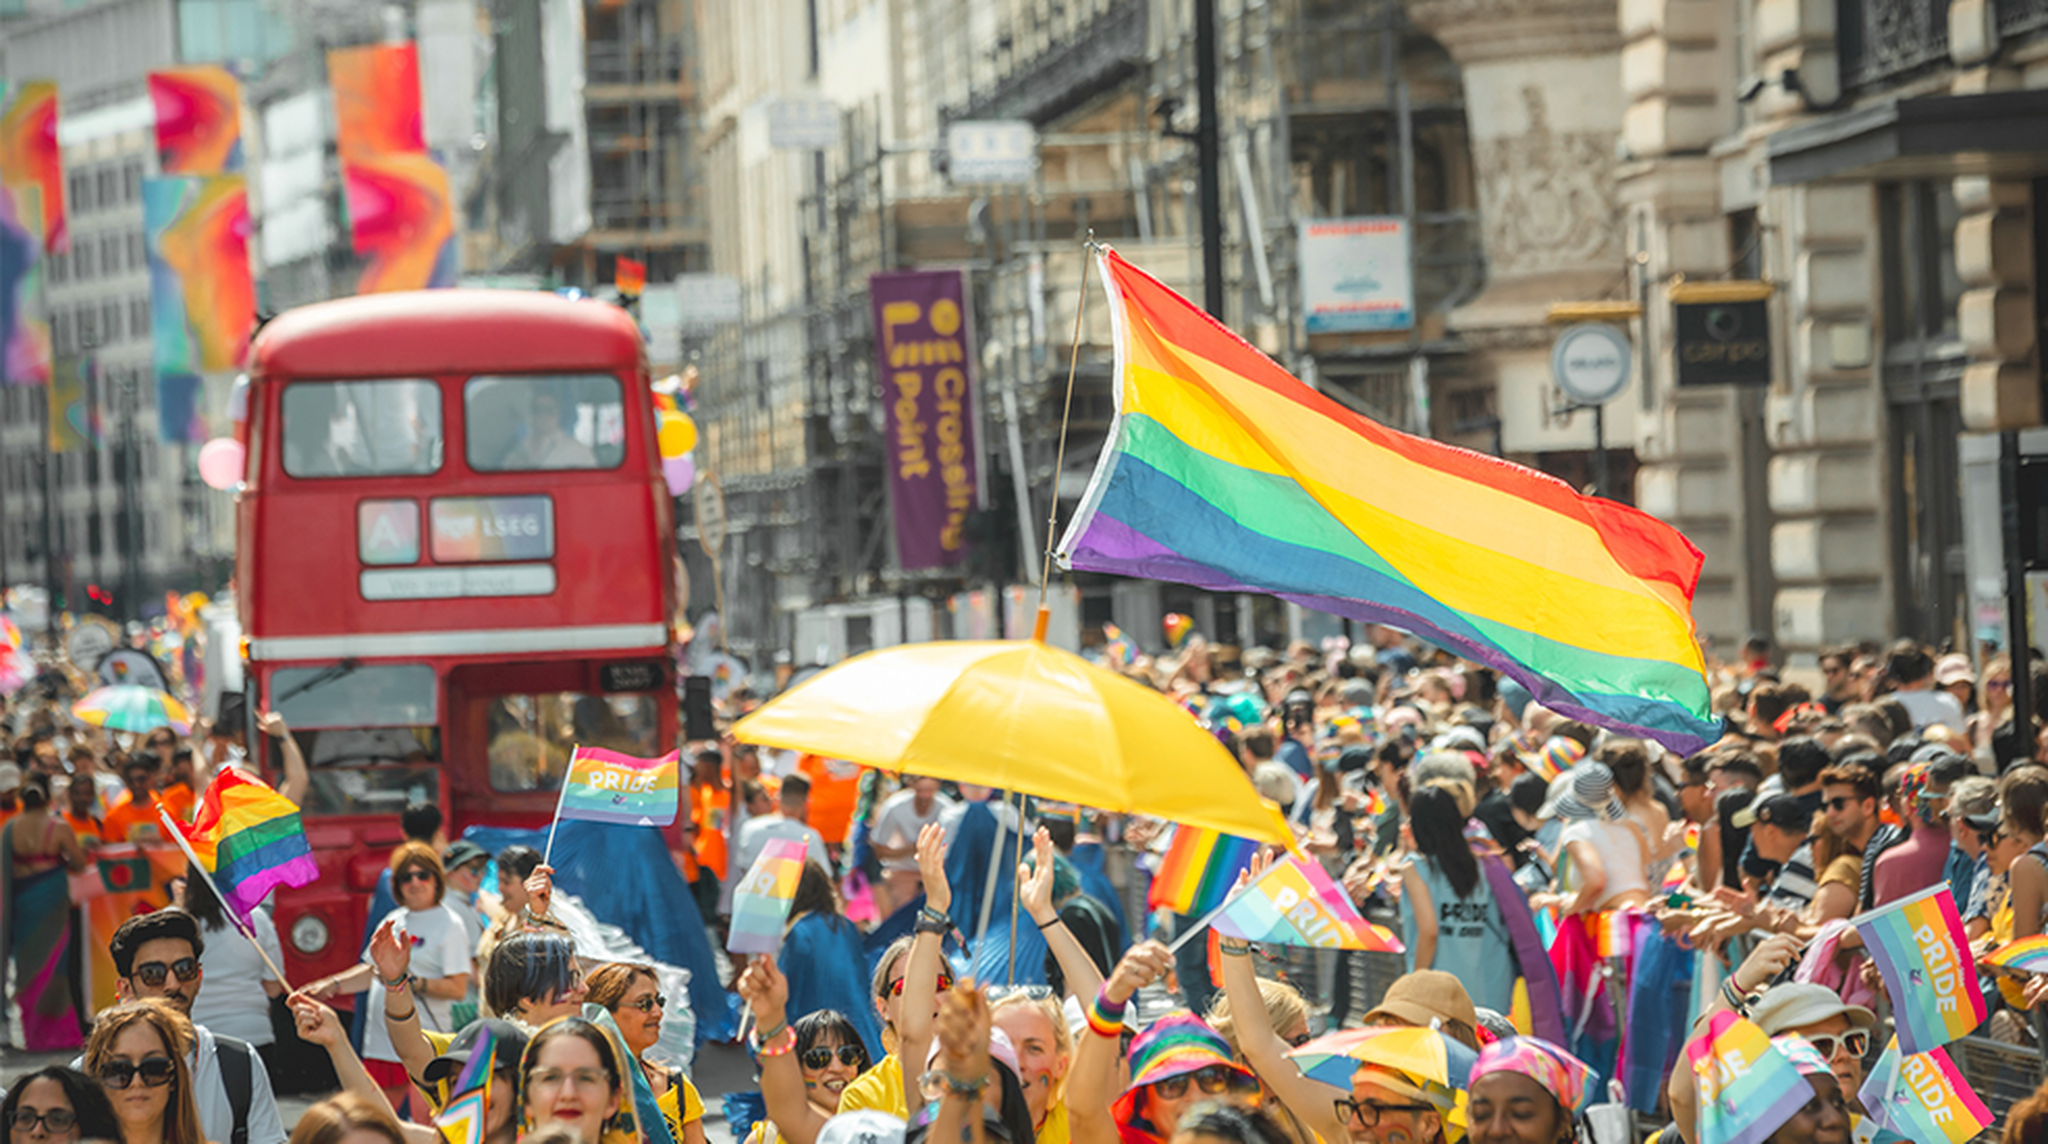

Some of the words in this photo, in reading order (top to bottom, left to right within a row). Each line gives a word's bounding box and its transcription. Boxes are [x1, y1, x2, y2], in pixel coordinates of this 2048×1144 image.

[893, 371, 931, 480] Point
[935, 367, 973, 551] Crossing
[371, 515, 401, 551] A
[482, 514, 540, 537] LSEG
[588, 770, 658, 795] PRIDE
[1271, 886, 1343, 949] PRID
[1912, 923, 1957, 1014] PRIDE
